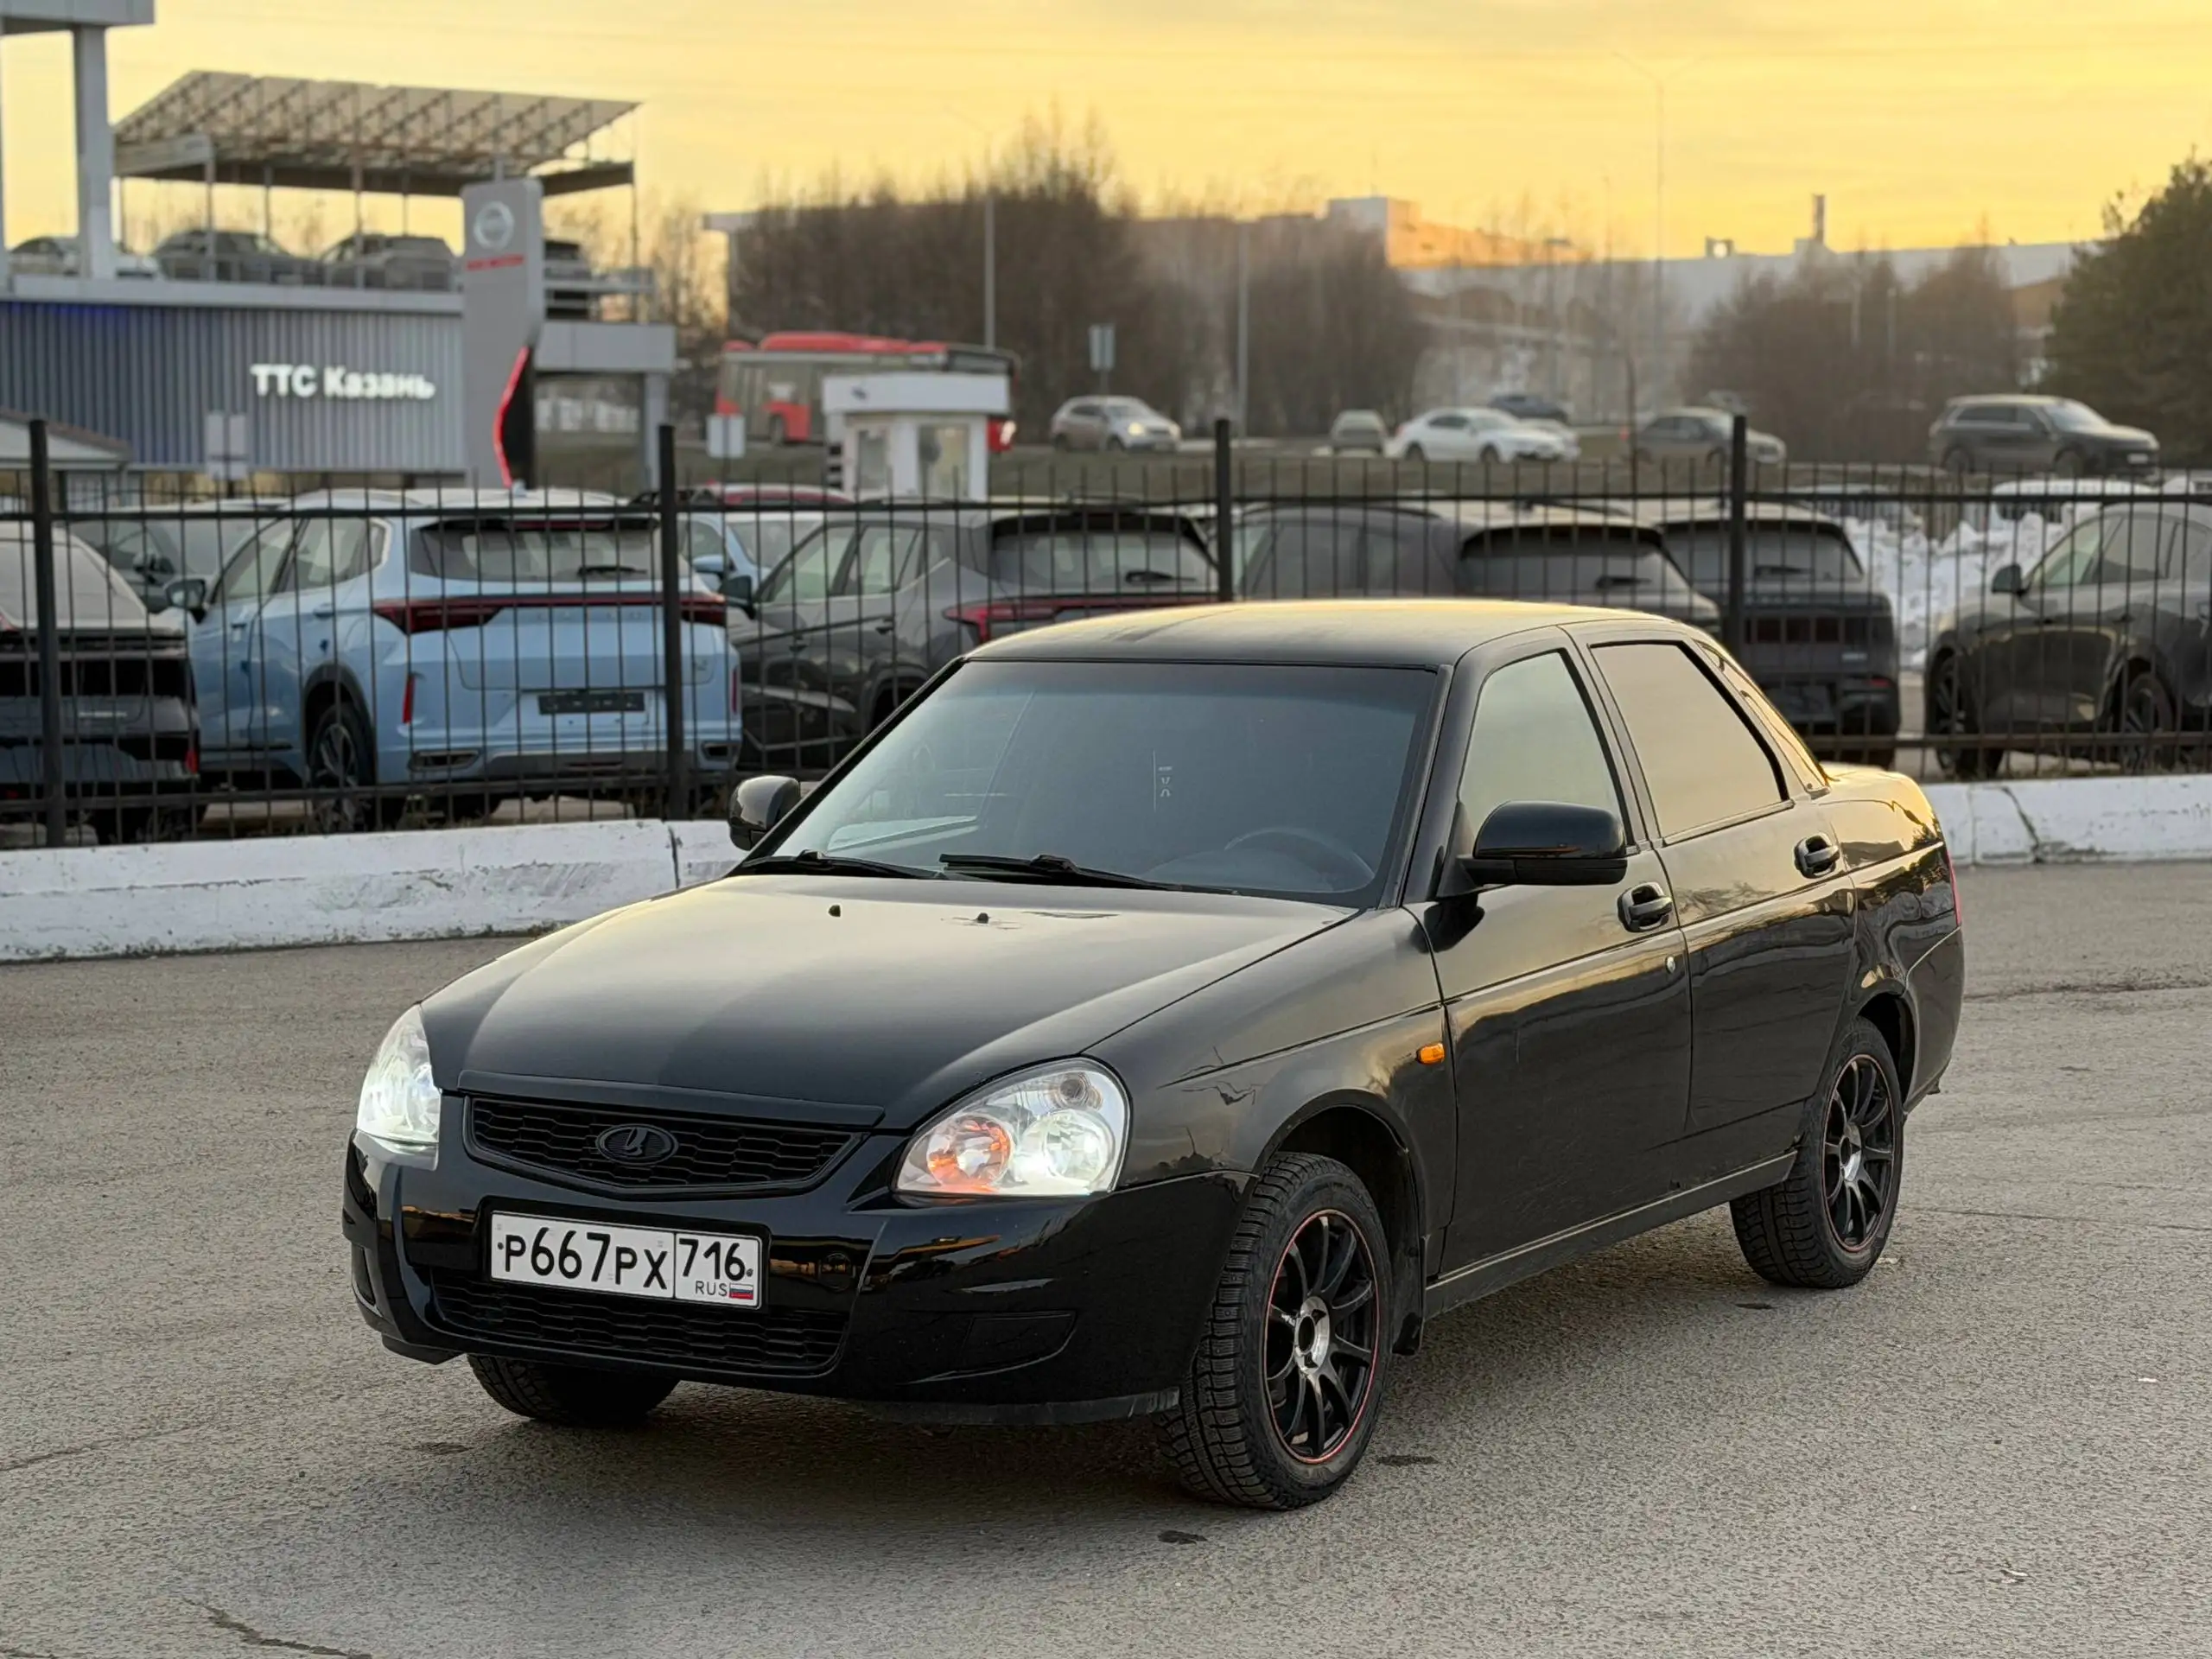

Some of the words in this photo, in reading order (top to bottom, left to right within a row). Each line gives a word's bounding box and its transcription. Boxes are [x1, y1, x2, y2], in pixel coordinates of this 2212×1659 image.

[323, 365, 436, 400] Казань
[678, 1237, 746, 1281] 716
[695, 1281, 728, 1297] RUS
